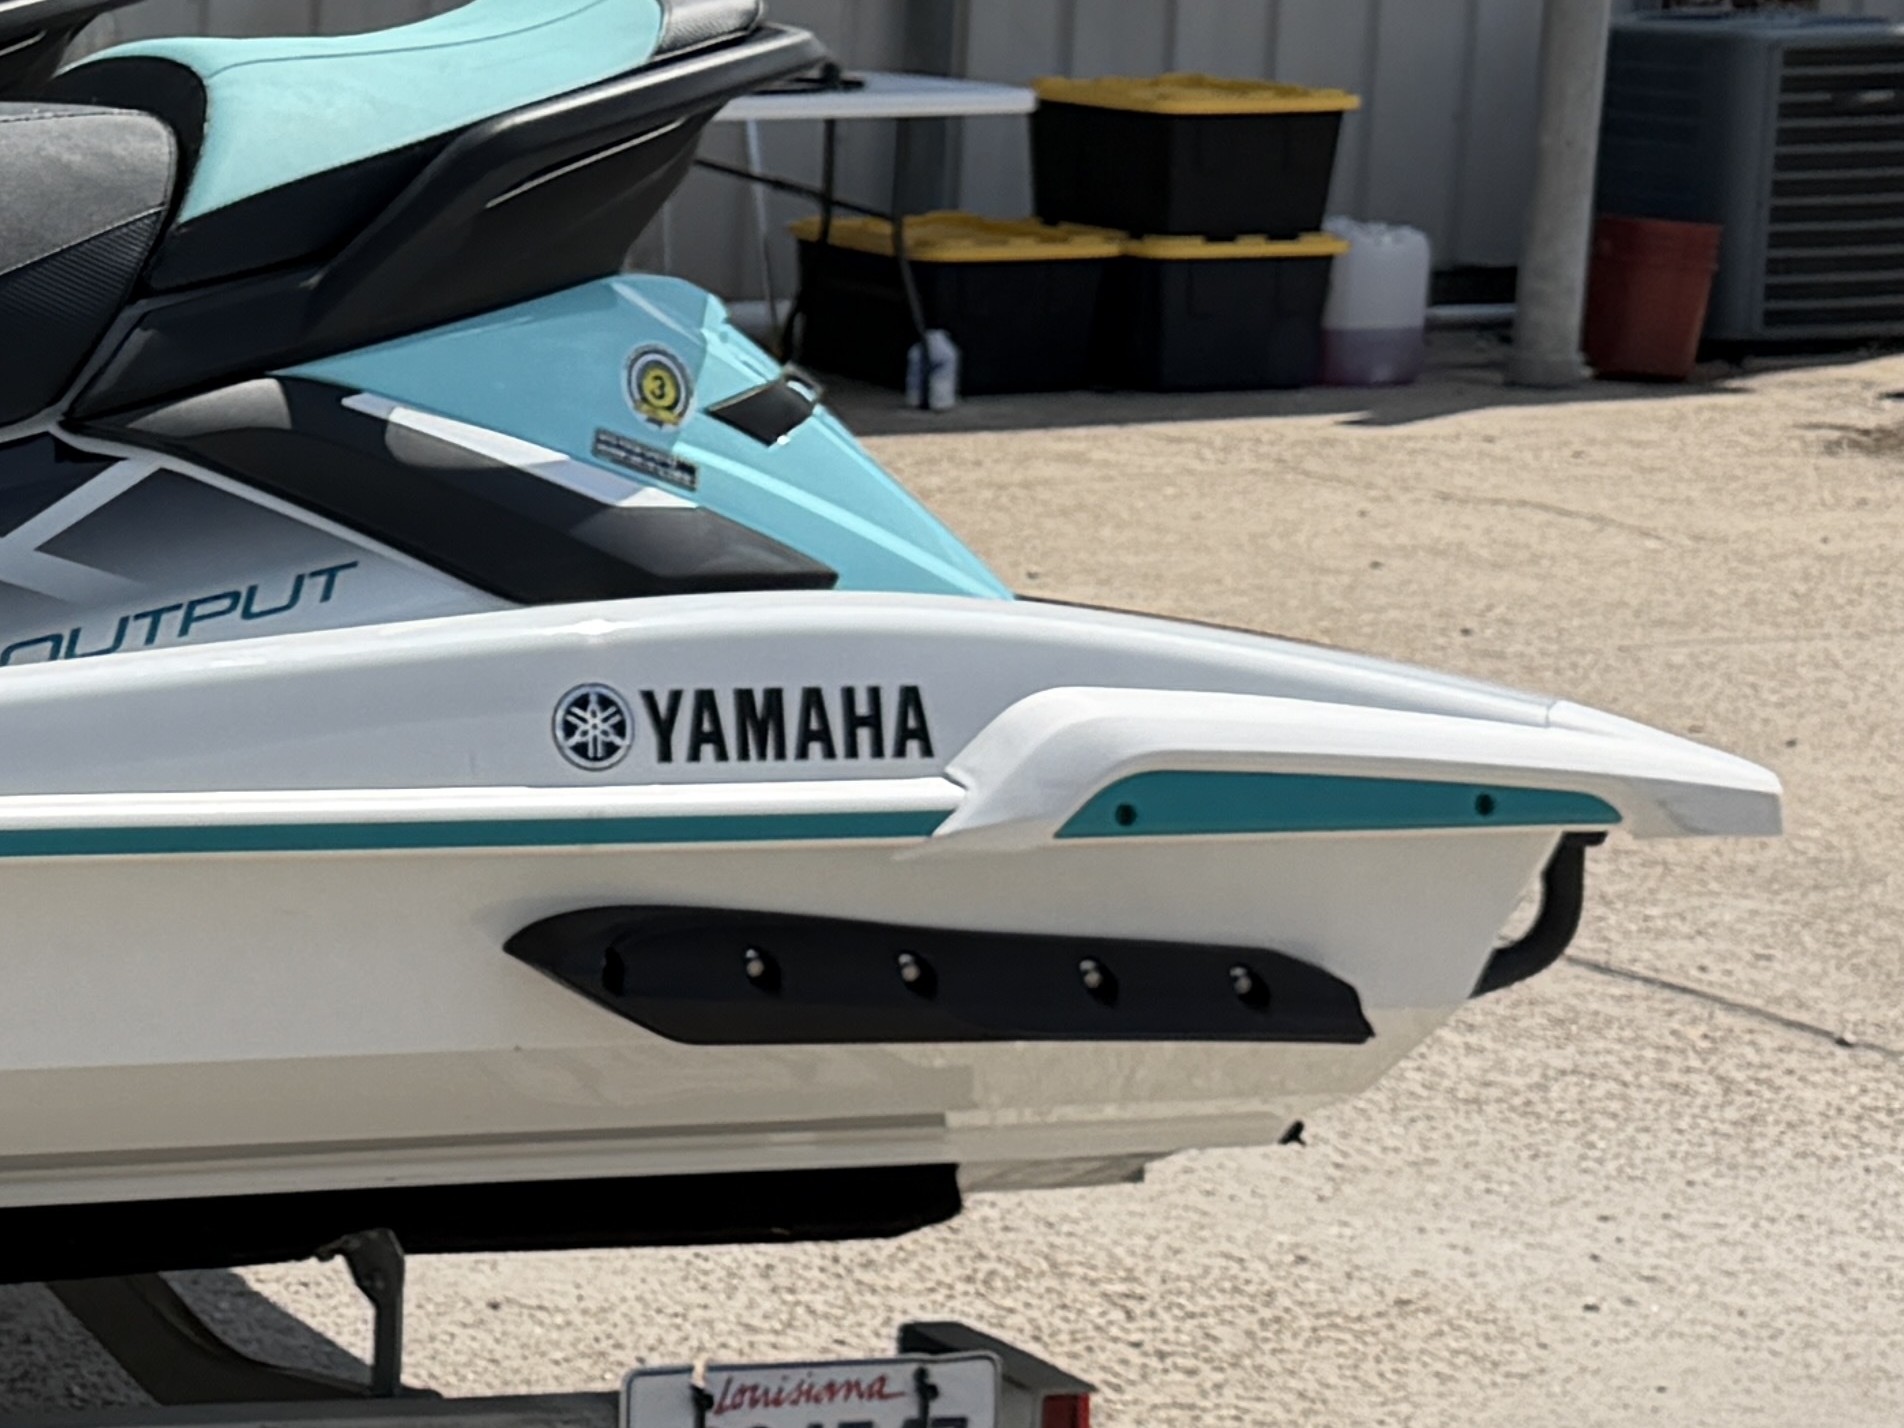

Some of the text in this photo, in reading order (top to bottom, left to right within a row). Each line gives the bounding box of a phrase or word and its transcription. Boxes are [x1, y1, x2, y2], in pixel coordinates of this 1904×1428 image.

[650, 374, 666, 401] 3
[639, 684, 935, 764] YAMAHA
[711, 1373, 907, 1417] Louisiana
